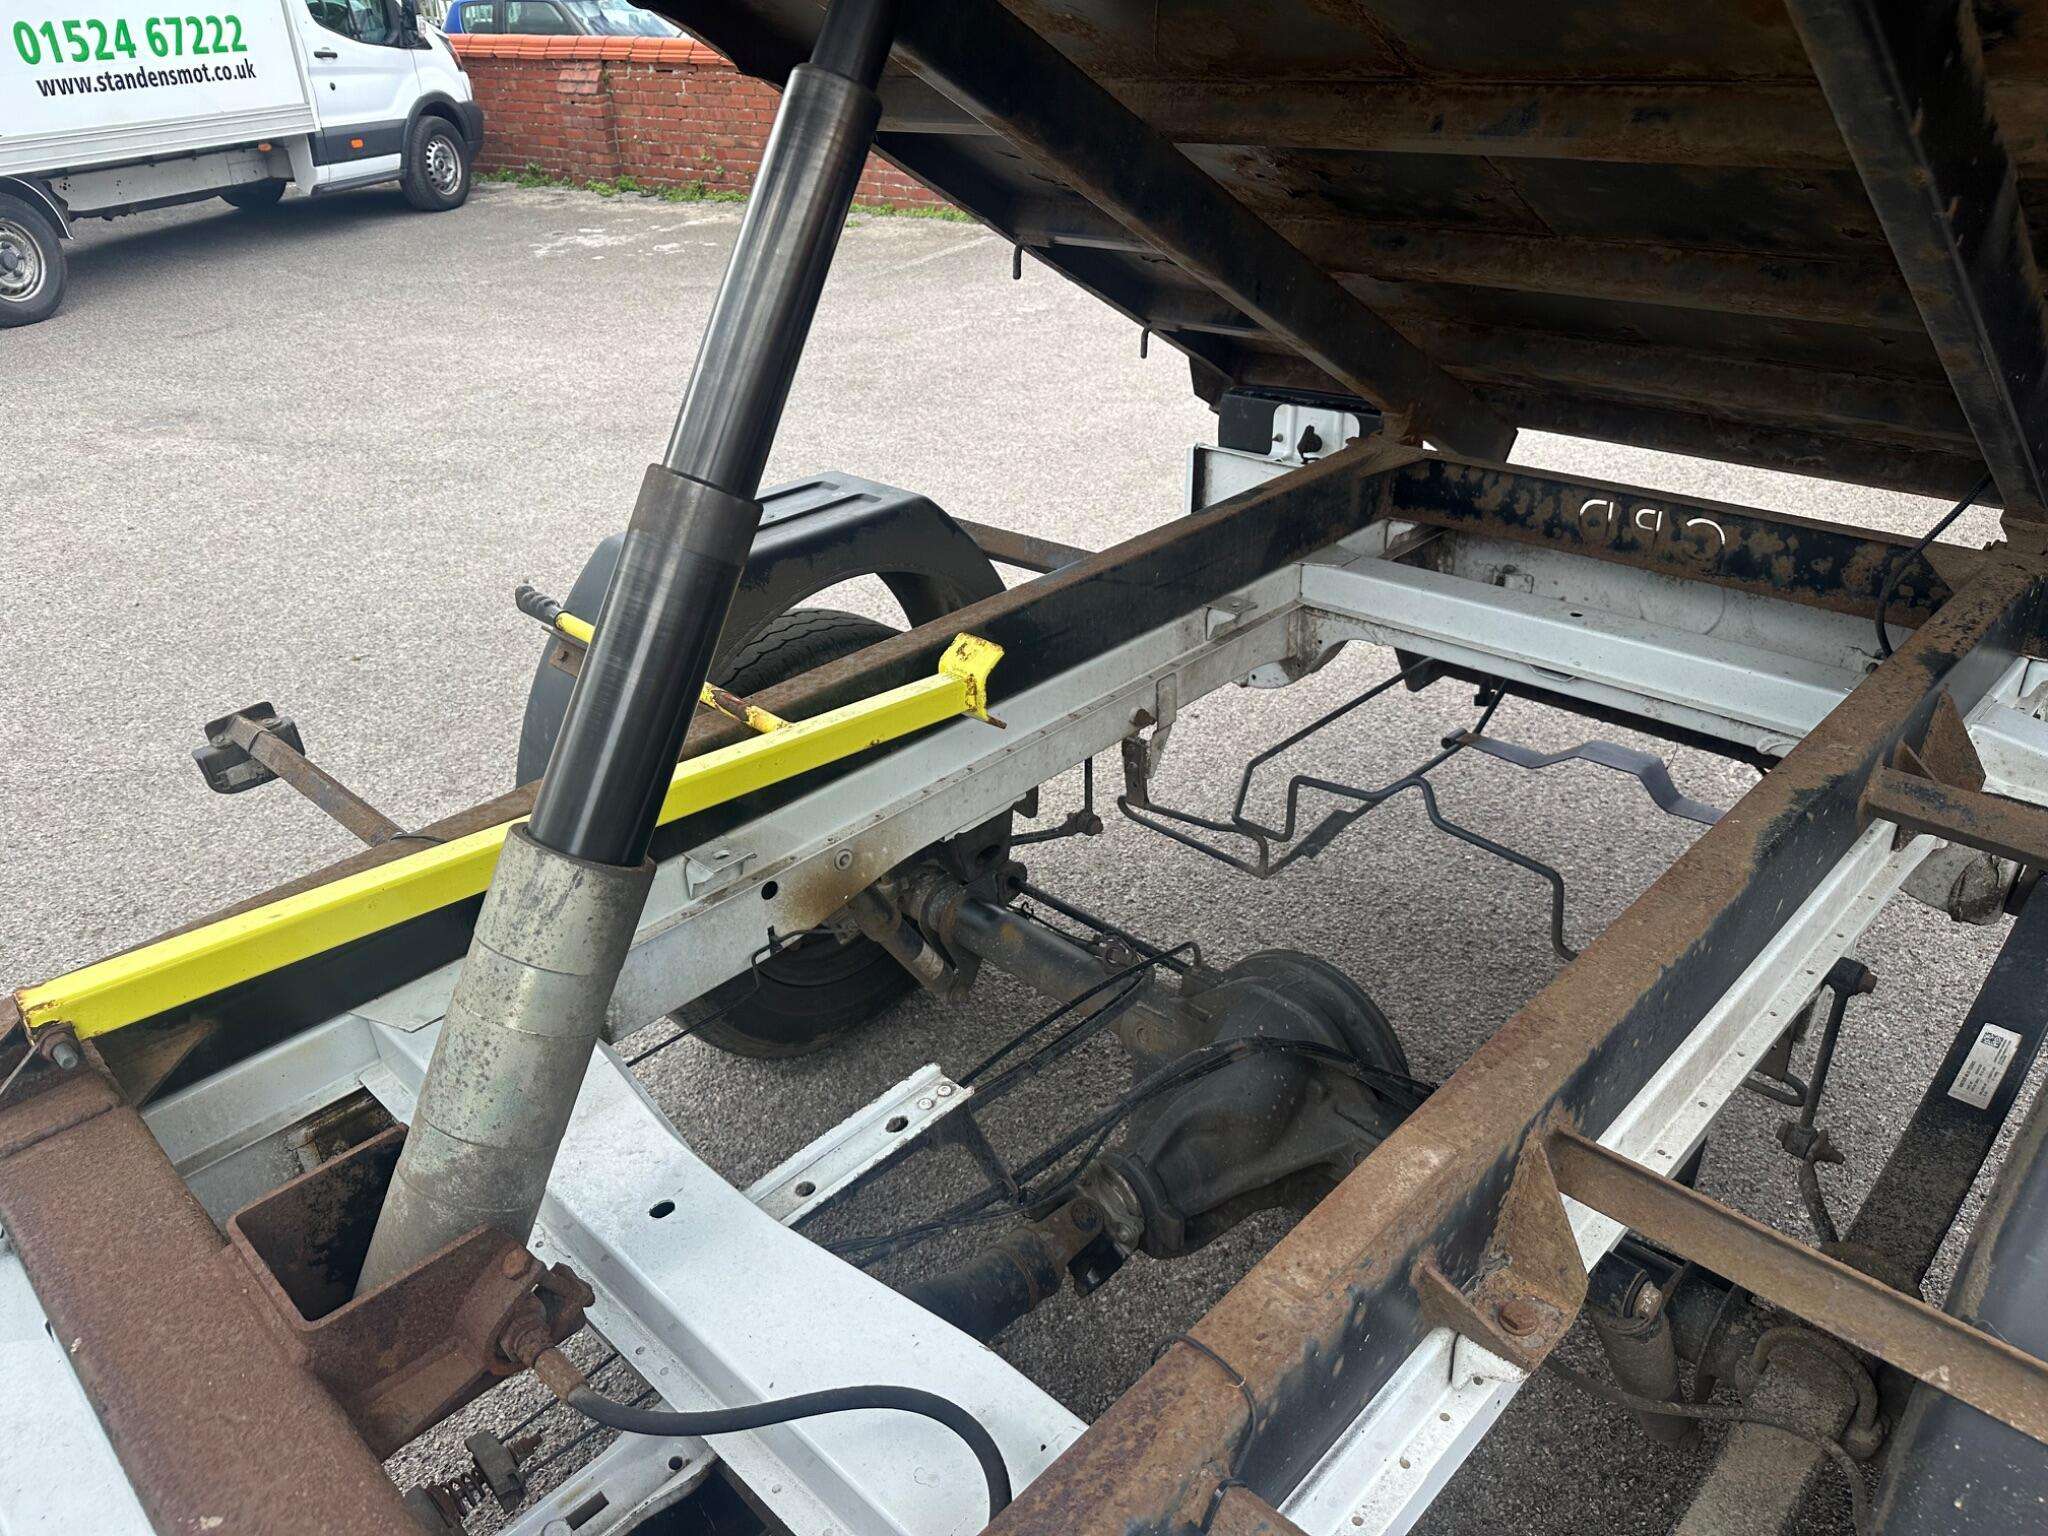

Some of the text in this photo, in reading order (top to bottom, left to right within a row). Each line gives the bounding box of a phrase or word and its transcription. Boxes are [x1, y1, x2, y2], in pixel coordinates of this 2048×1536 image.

[12, 14, 248, 65] 01524 67222
[36, 58, 256, 97] www.standensmot.co.uk
